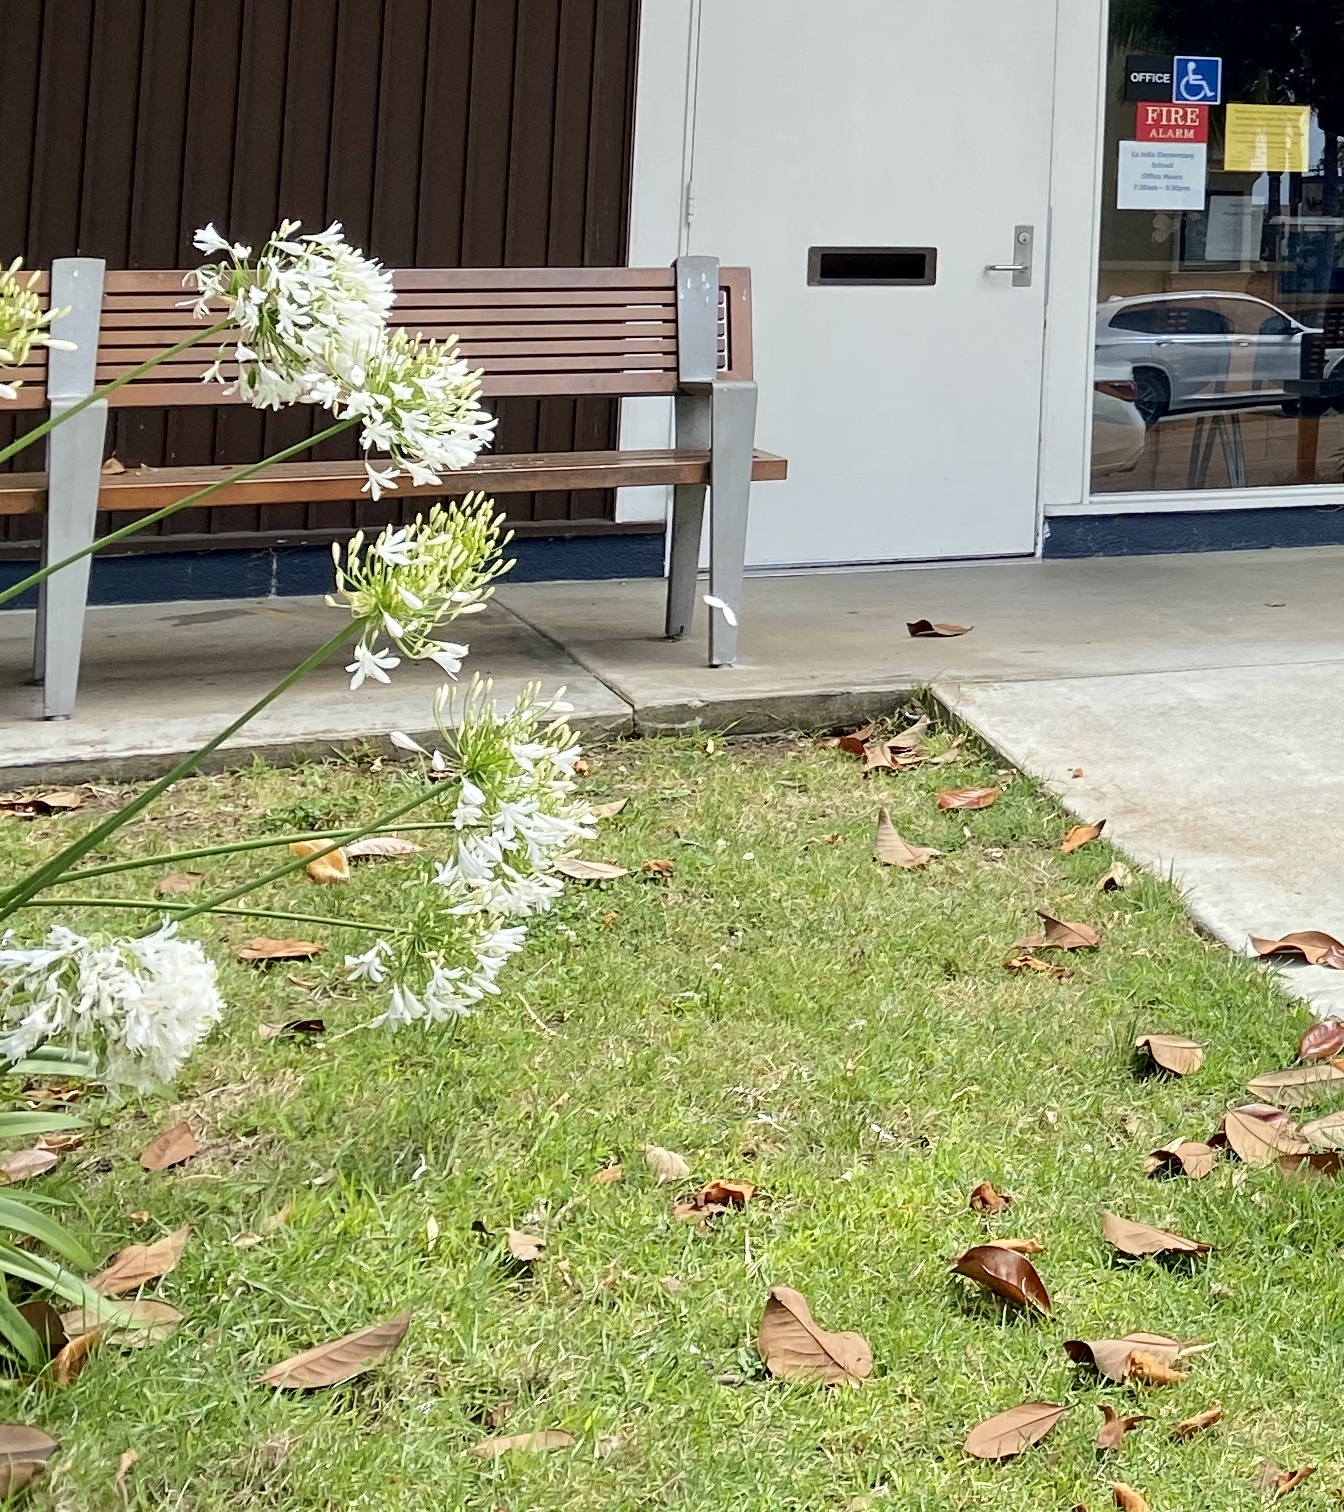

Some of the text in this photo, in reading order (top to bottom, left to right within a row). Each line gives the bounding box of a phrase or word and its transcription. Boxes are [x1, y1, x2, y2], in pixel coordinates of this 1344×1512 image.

[1130, 72, 1171, 84] OFFICE
[1145, 106, 1200, 127] FIRE
[1149, 128, 1195, 139] ALARM
[1141, 172, 1162, 180] Office
